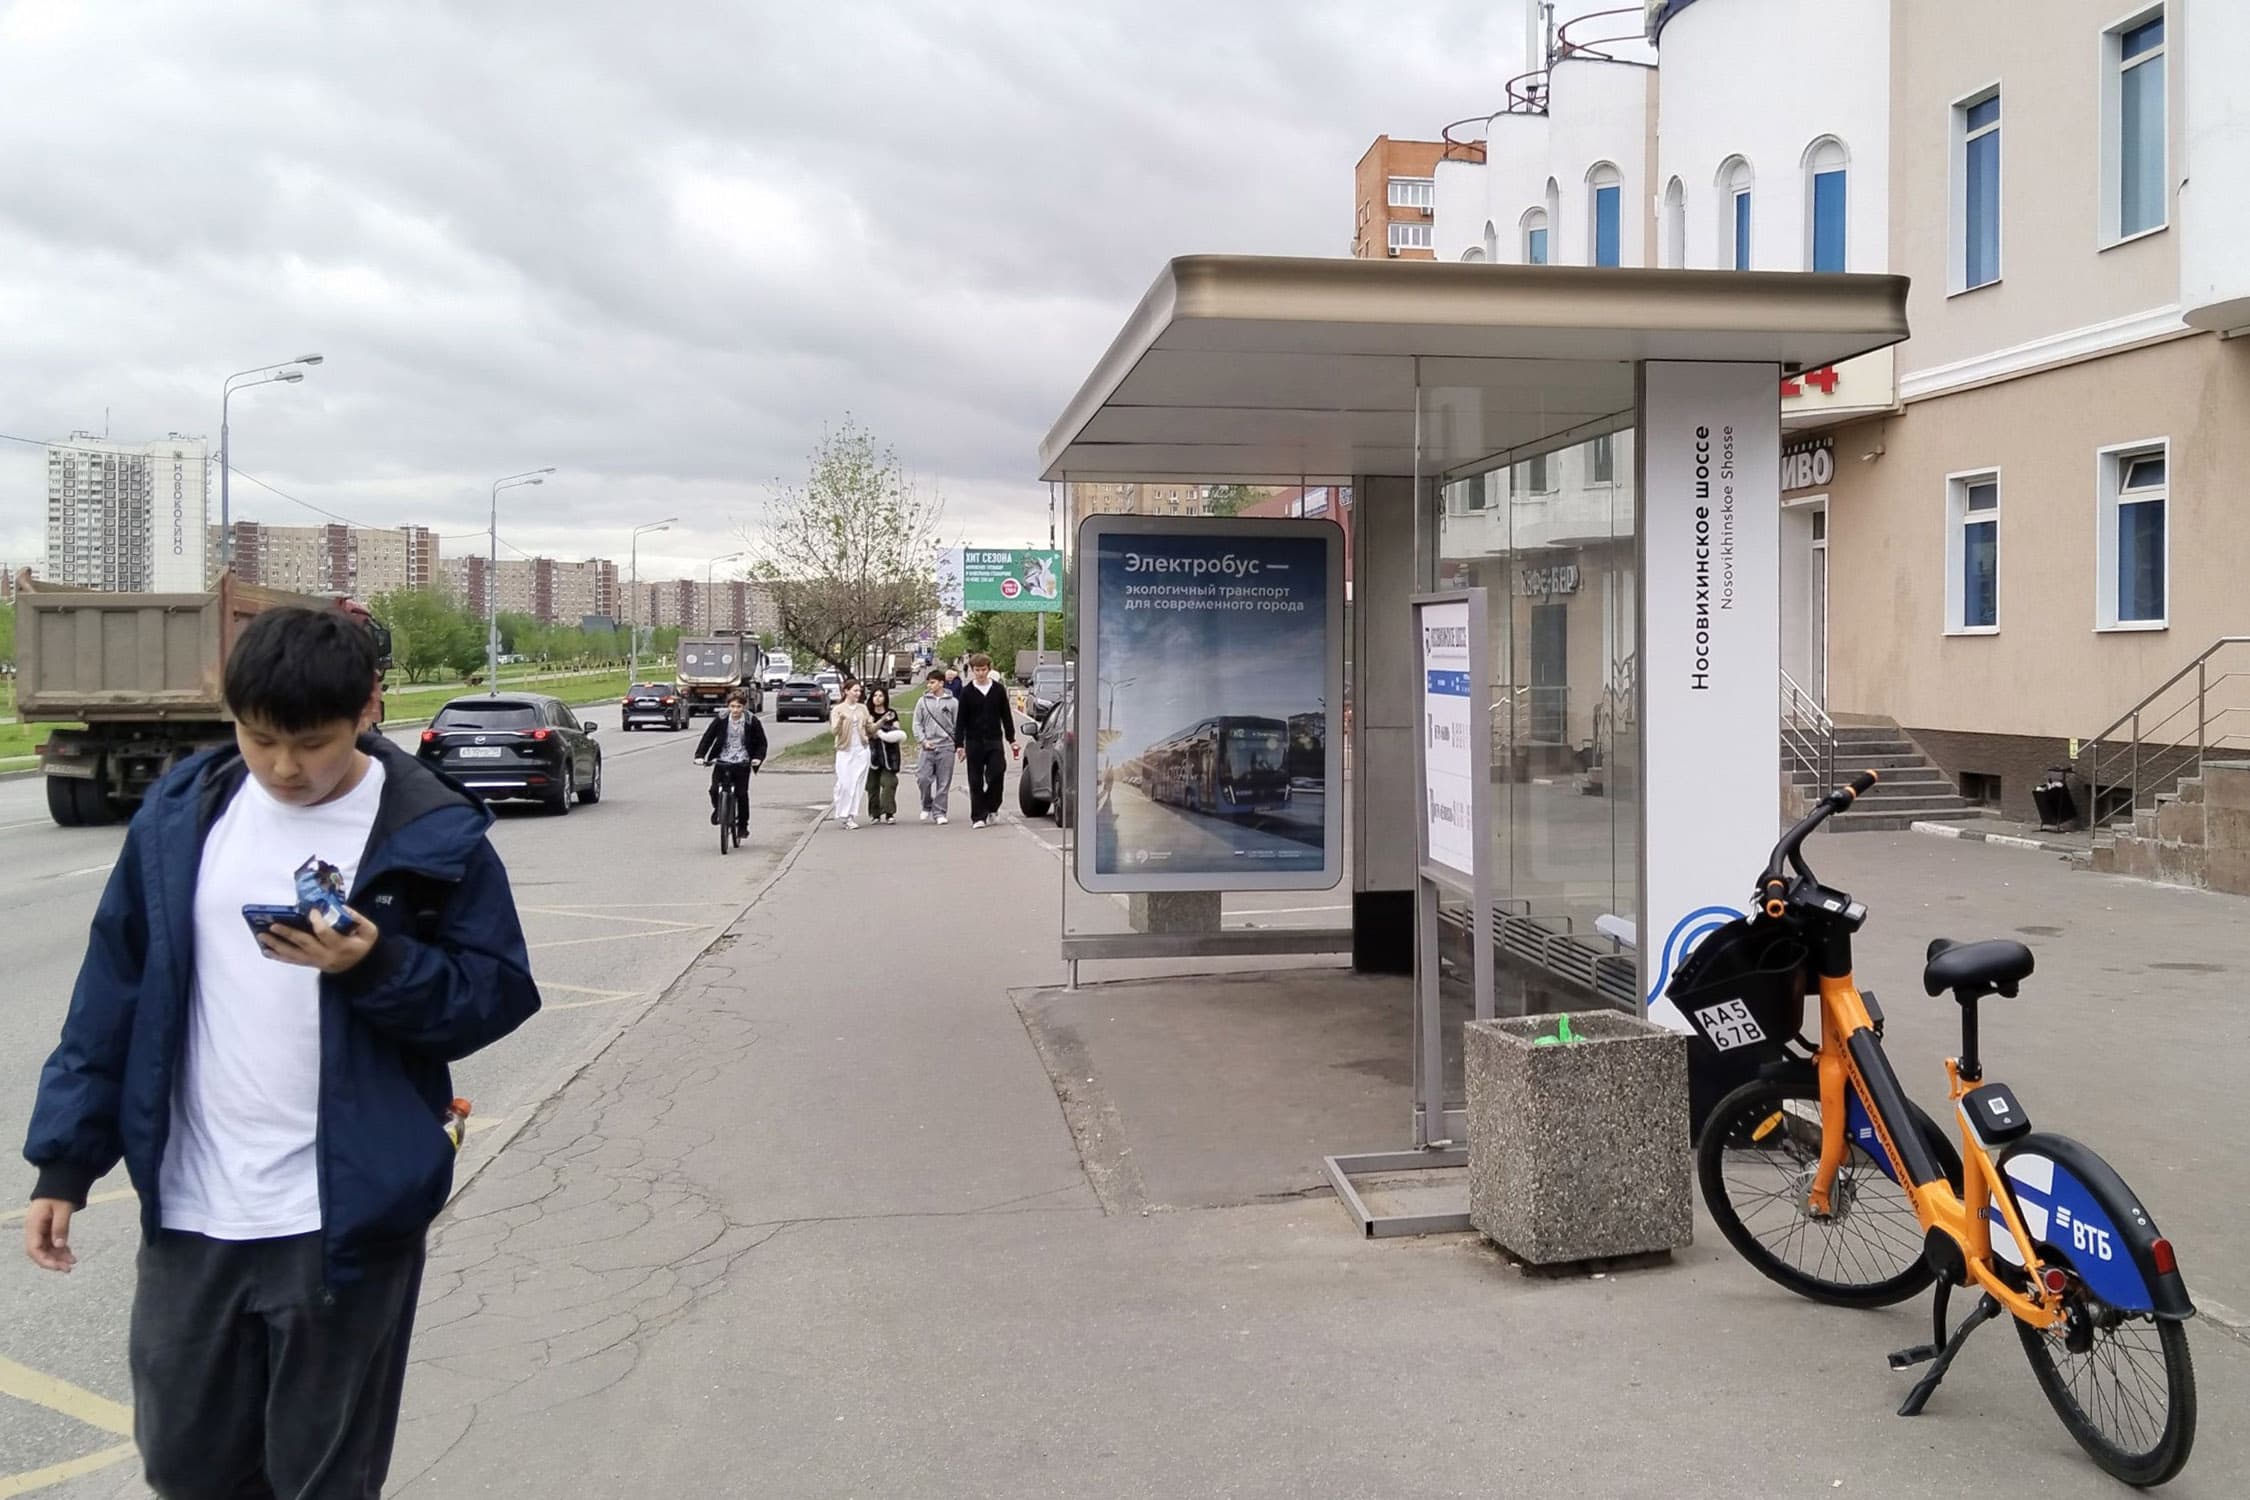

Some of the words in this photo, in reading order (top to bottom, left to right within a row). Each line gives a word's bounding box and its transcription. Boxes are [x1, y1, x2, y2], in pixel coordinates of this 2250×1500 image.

[1696, 425, 1710, 498] шоссе
[1720, 425, 1733, 479] Shosse
[1782, 448, 1833, 490] ИВО
[173, 463, 183, 556] НОВОКОСИНО
[965, 553, 980, 563] ХИТ
[982, 553, 1013, 563] СЕЗОНА
[1124, 553, 1260, 577] Электробус
[1720, 486, 1733, 610] Nosovikhinskoe
[1125, 584, 1216, 598] экологичный
[1219, 586, 1290, 598] транспорт
[1125, 600, 1151, 611] для
[1154, 600, 1254, 612] современного
[1257, 601, 1304, 613] города
[1691, 505, 1710, 690] Носовихинское
[2072, 1219, 2113, 1261] ВТБ
